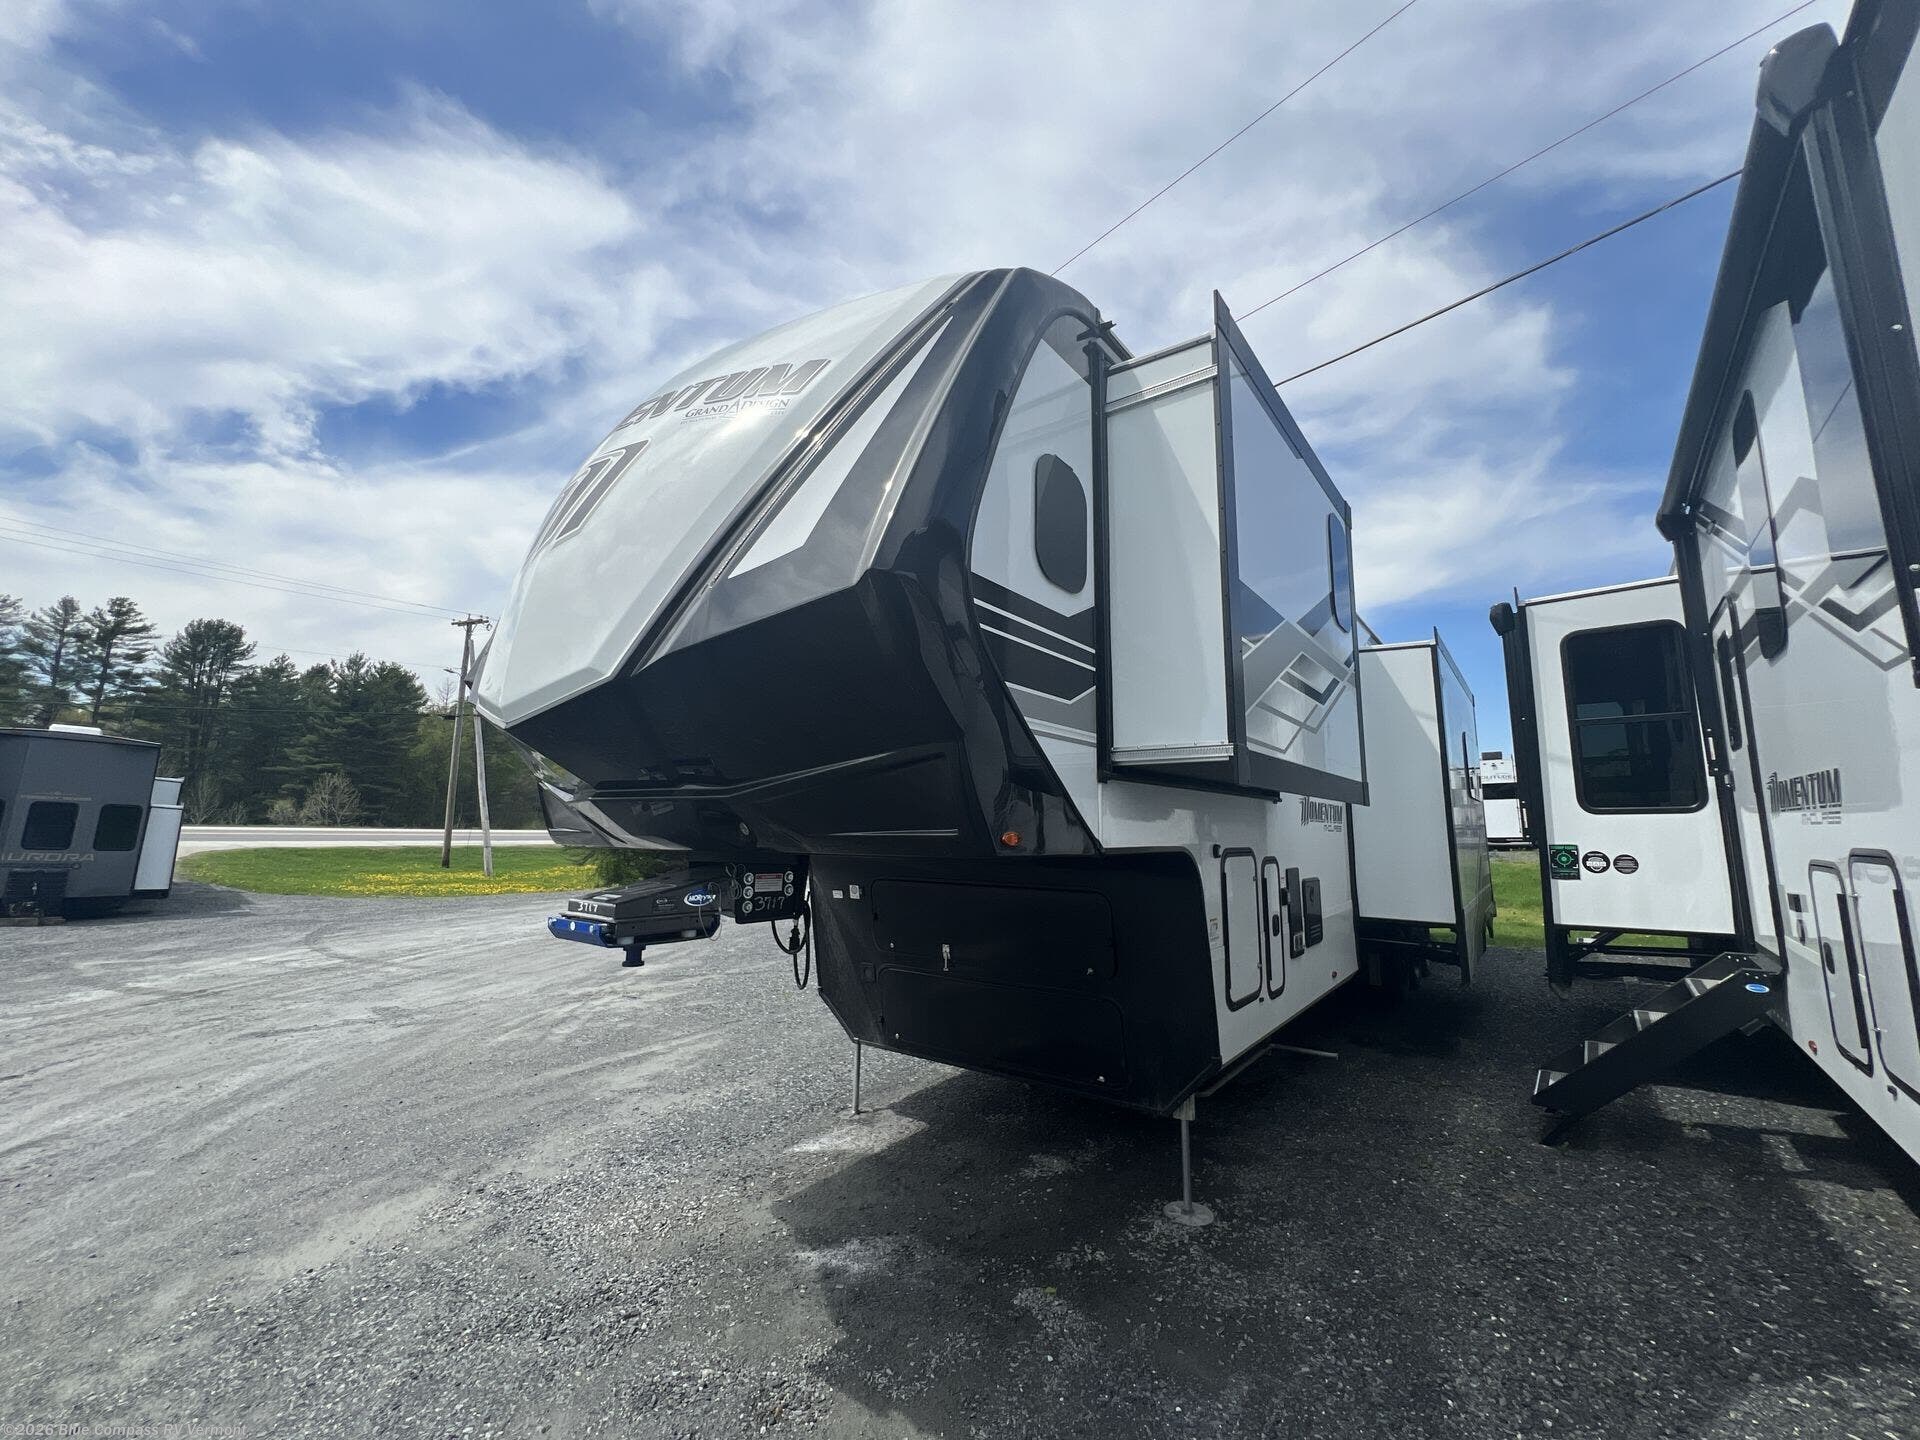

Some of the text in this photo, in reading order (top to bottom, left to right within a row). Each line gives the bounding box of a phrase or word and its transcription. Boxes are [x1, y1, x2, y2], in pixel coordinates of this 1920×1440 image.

[685, 404, 729, 417] GRAND
[577, 901, 599, 913] 3717
[754, 896, 785, 911] 3717
